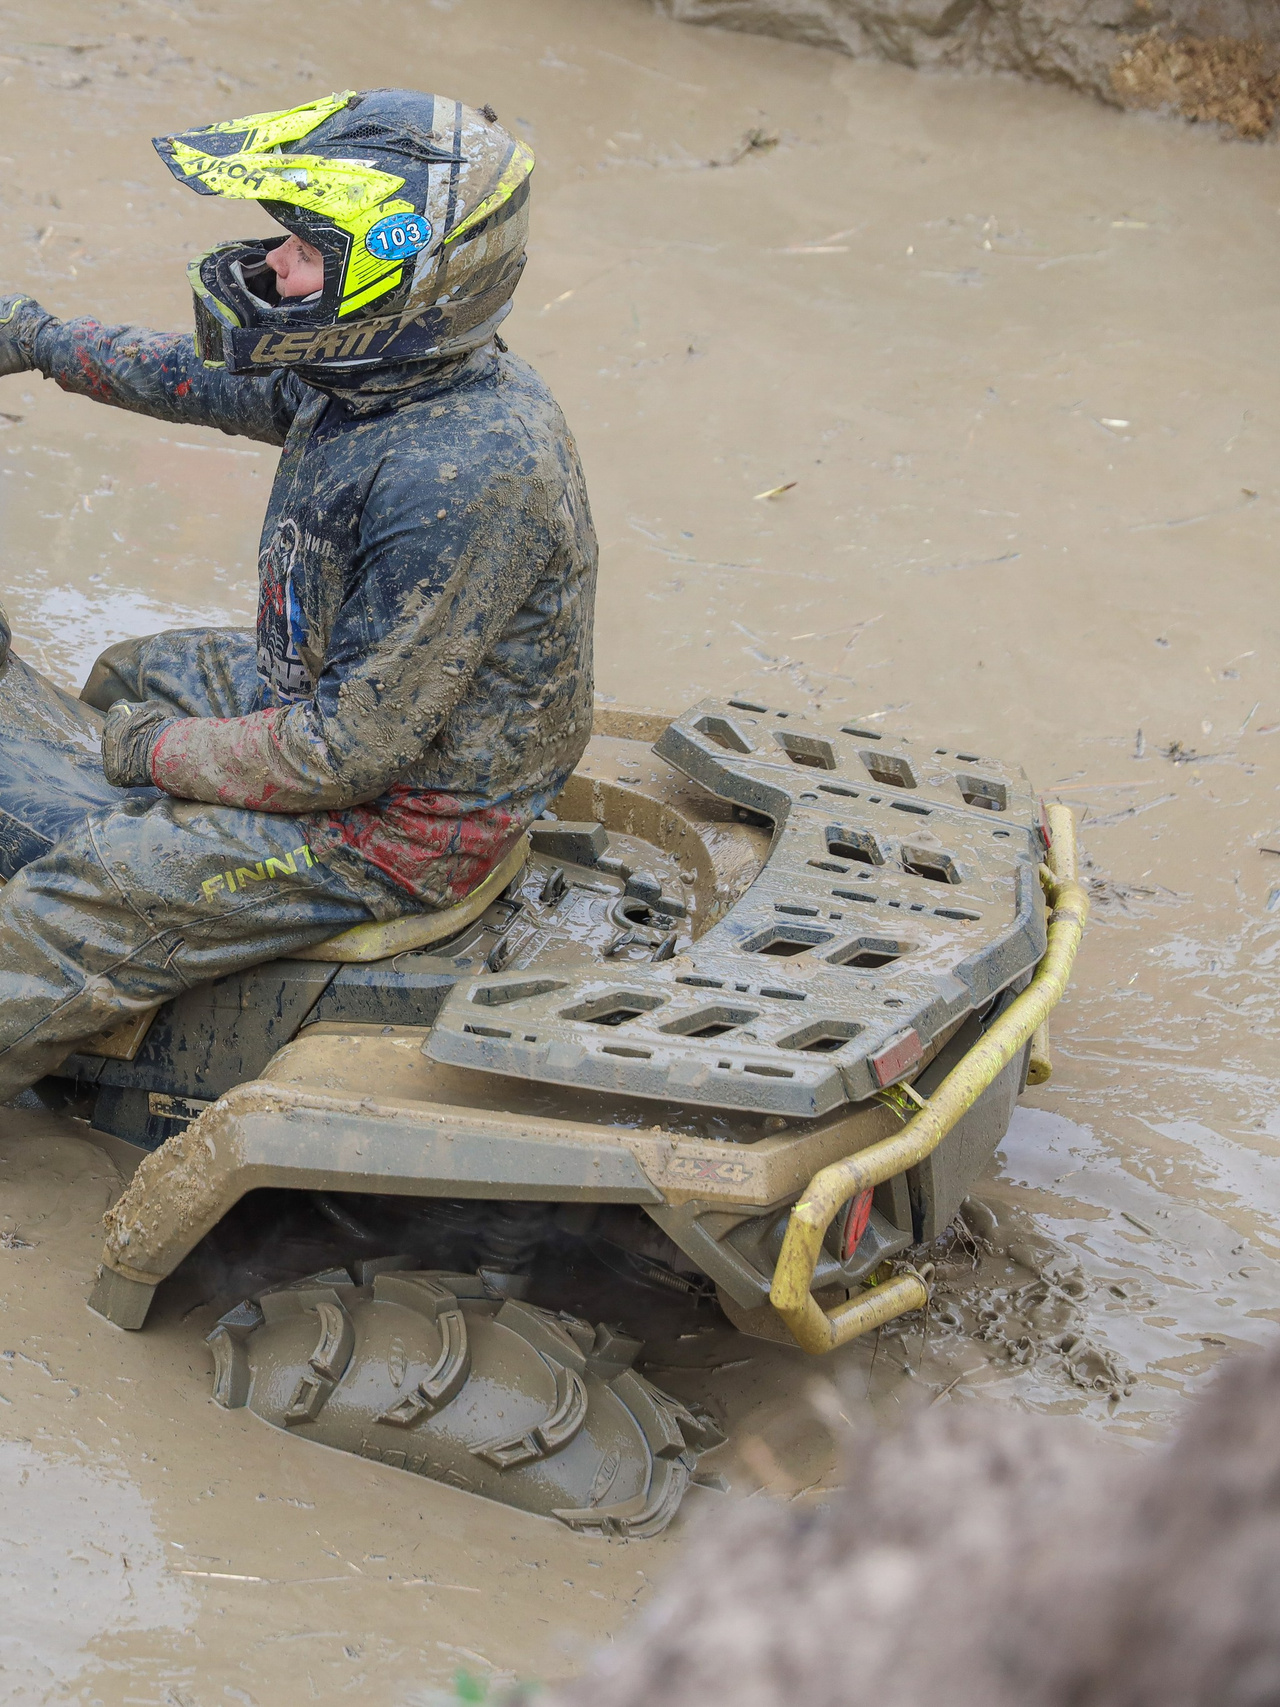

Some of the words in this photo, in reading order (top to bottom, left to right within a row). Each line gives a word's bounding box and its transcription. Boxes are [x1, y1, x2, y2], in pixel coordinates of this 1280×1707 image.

[376, 223, 421, 250] 103
[250, 321, 392, 363] LEATT
[201, 845, 319, 904] FINNT
